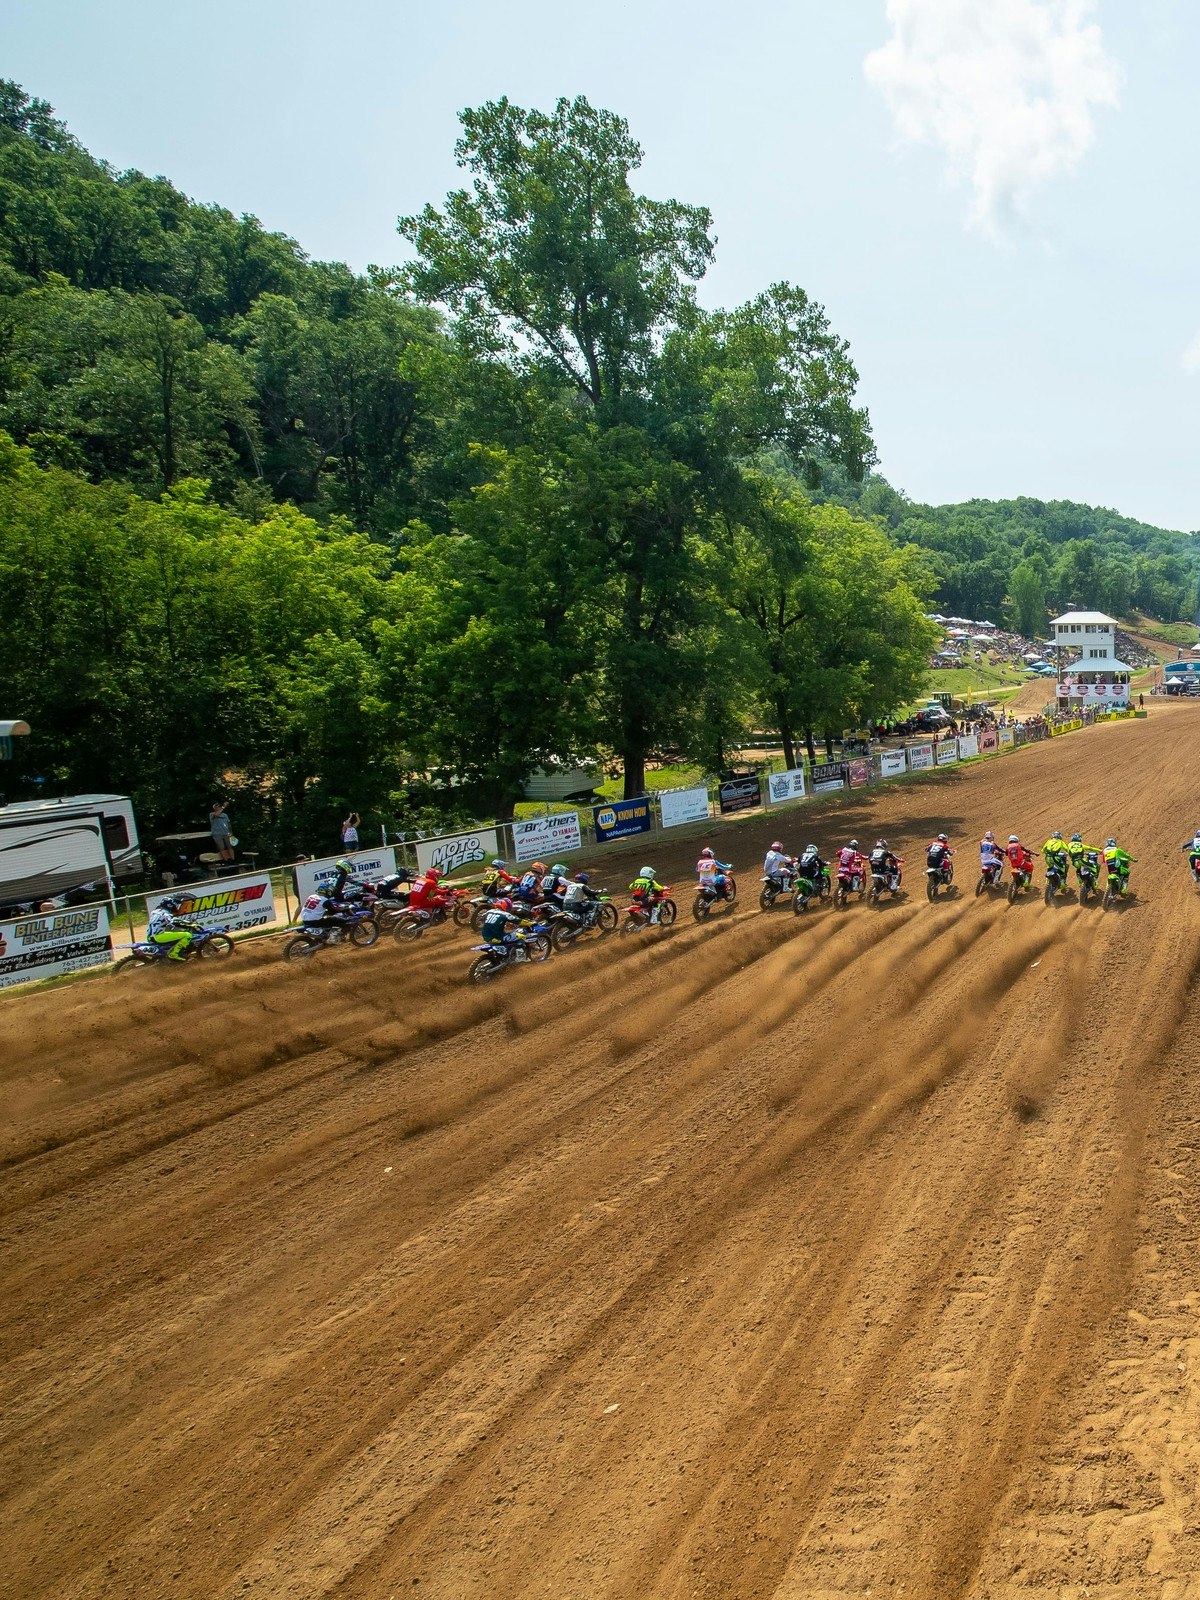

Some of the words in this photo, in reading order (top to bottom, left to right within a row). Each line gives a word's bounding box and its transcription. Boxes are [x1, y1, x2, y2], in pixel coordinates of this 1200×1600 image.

[600, 813, 615, 824] NAPA
[618, 808, 634, 821] KNOW
[634, 806, 647, 818] HOW
[526, 835, 549, 843] HONDA
[558, 826, 578, 835] YAMAHA
[430, 838, 480, 868] MOTO
[441, 848, 485, 876] TEES
[314, 866, 357, 882] AMEN
[358, 861, 382, 872] HOME
[177, 883, 268, 915] AINVIEW
[250, 906, 272, 915] YAMAHA
[15, 920, 48, 938] BILL
[53, 909, 100, 930] BUNE
[22, 922, 98, 946] ENTERPRISES
[28, 934, 98, 952] www.billbune.com
[36, 945, 68, 958] Sleeving
